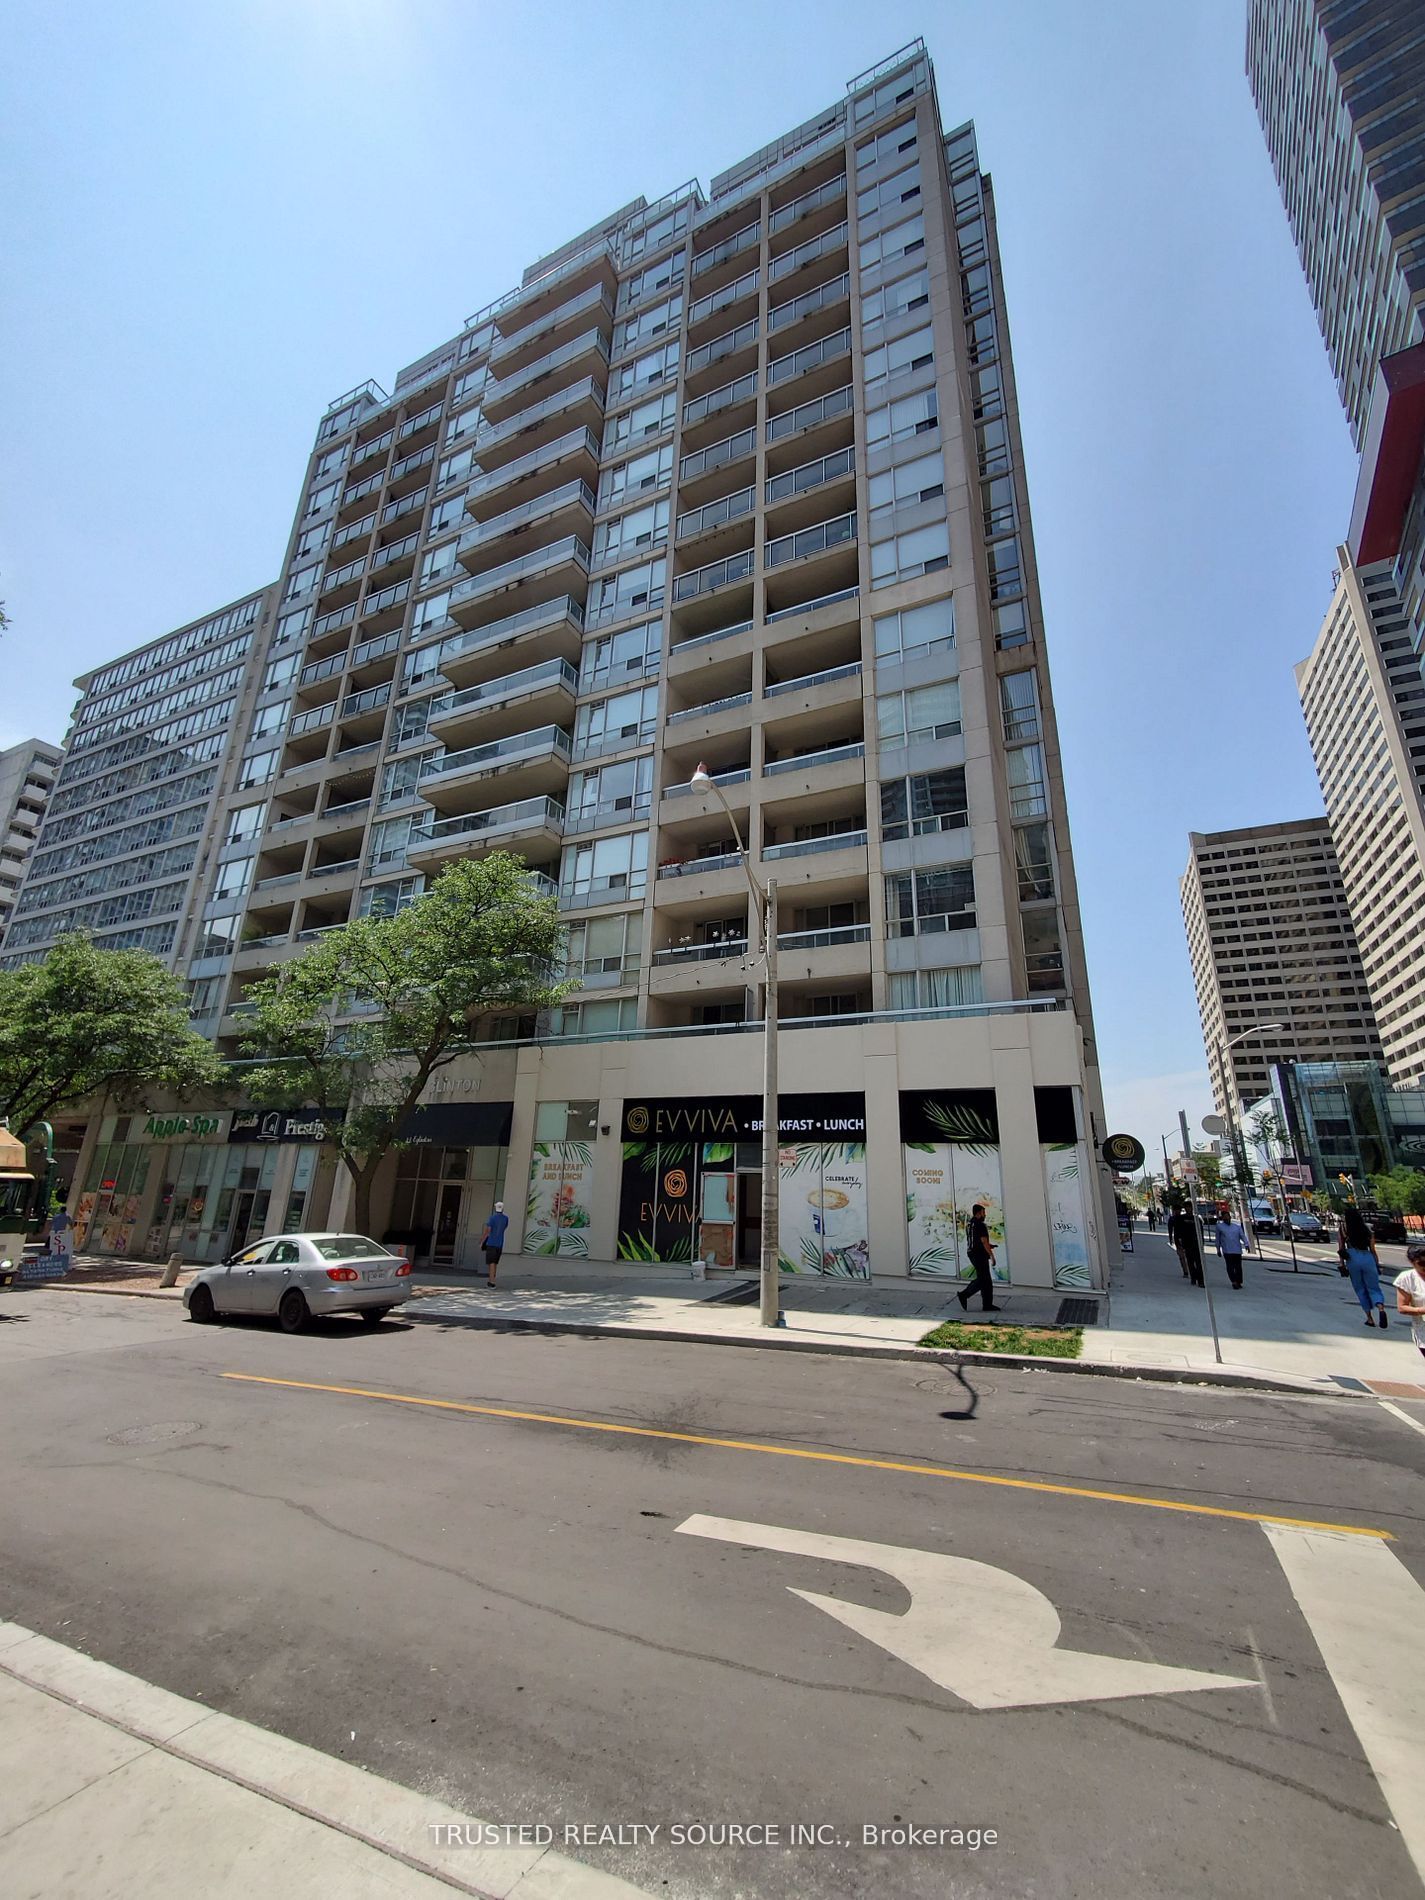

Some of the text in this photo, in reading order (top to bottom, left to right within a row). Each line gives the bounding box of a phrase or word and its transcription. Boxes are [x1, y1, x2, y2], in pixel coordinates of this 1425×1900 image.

[143, 1115, 190, 1139] Apple
[192, 1115, 222, 1139] Spa
[656, 1109, 864, 1133] EVVIVA BRKFAST LUNCH
[912, 1169, 943, 1177] COMING
